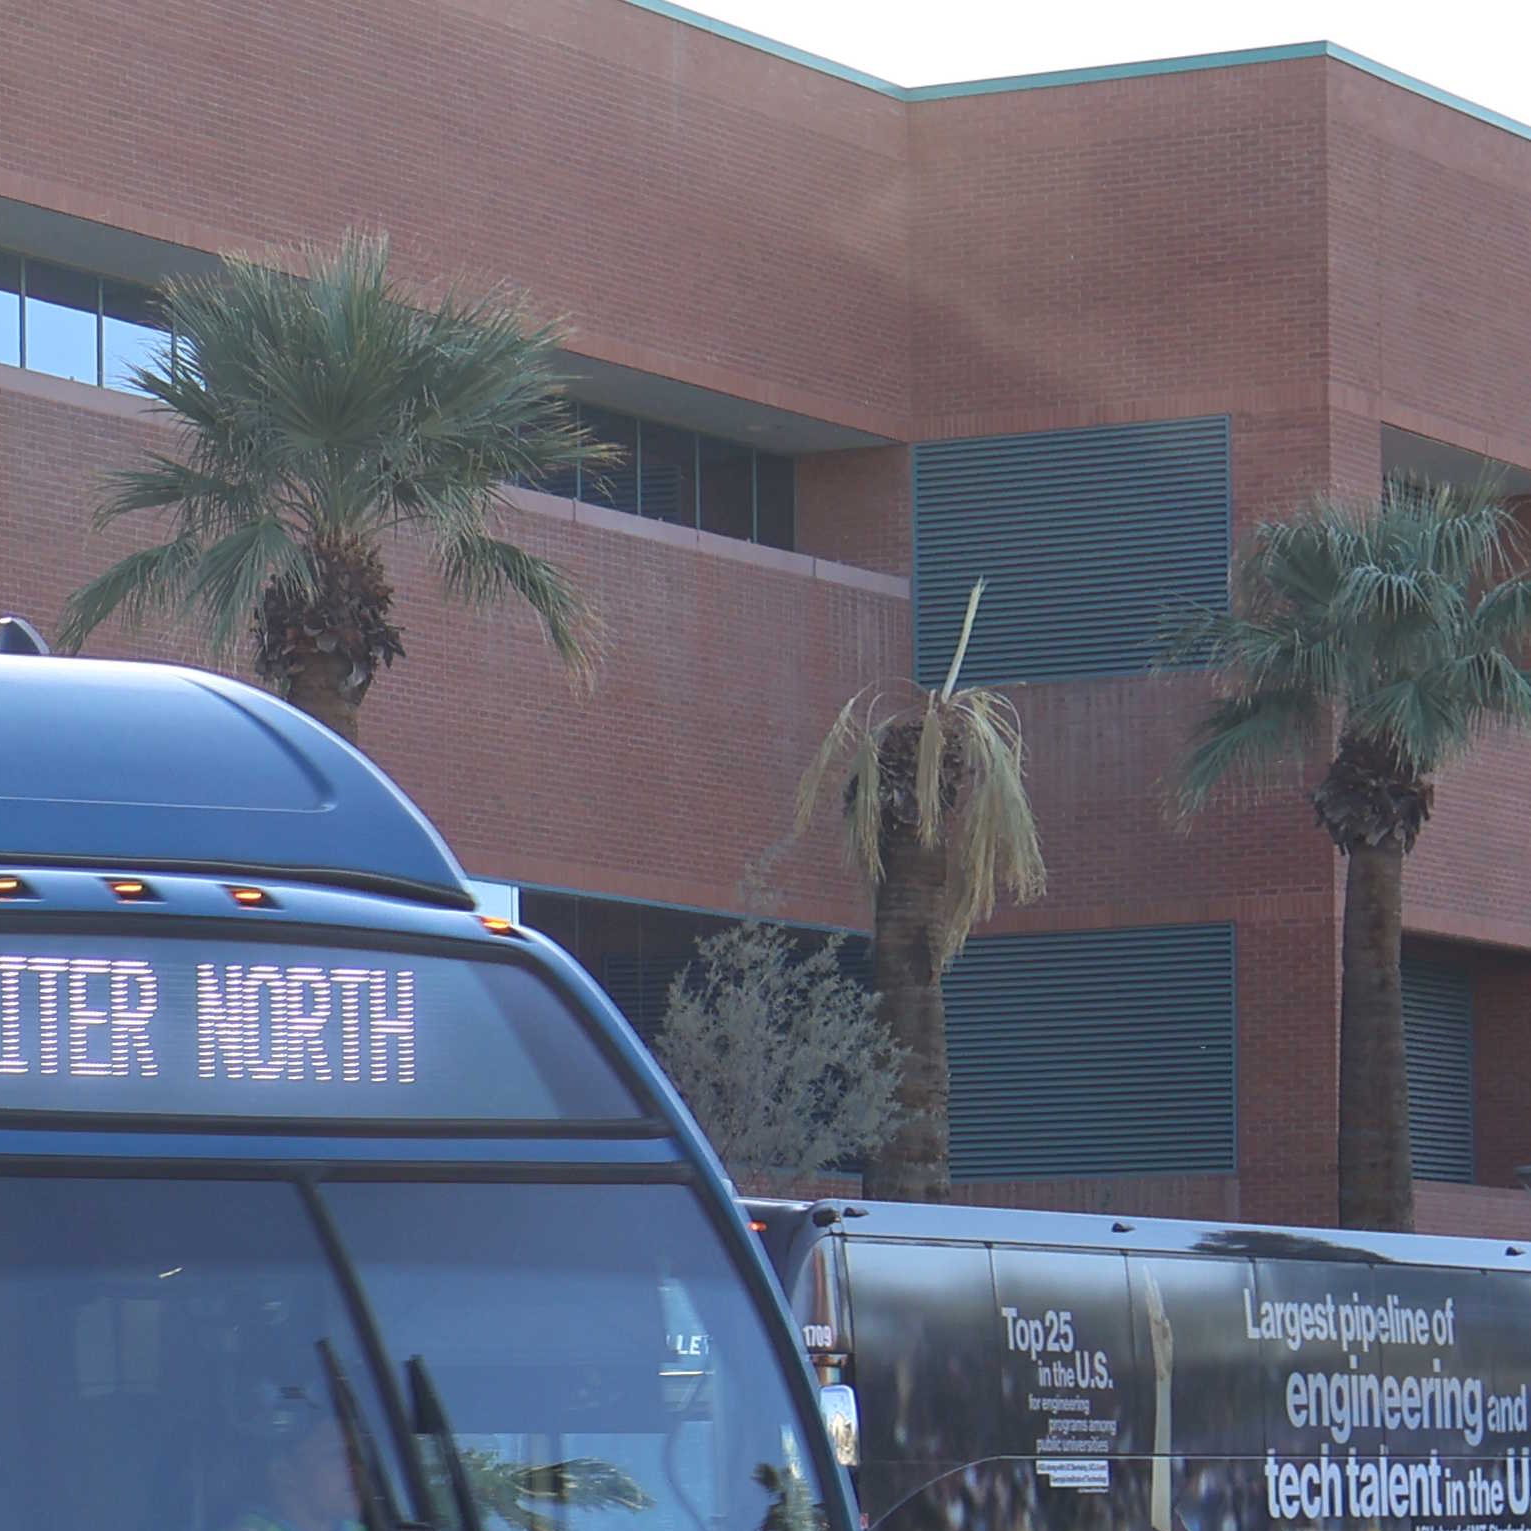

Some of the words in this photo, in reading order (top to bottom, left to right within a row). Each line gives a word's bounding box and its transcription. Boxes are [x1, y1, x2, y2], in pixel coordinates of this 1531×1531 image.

[197, 964, 416, 1084] NORTH
[1001, 1307, 1044, 1361] Top
[1045, 1310, 1074, 1353] 25
[1244, 1288, 1338, 1351] Largest
[1338, 1292, 1430, 1352] pipeline
[1432, 1298, 1455, 1346] of
[1038, 1360, 1052, 1387] in
[1053, 1361, 1075, 1388] the
[1075, 1350, 1114, 1389] U.S.
[1286, 1355, 1484, 1446] engineering
[1487, 1384, 1528, 1433] and
[1042, 1394, 1090, 1415] engineering
[1265, 1442, 1343, 1519] tech
[1345, 1444, 1441, 1518] talent
[1444, 1468, 1465, 1517] in
[1469, 1467, 1504, 1516] the
